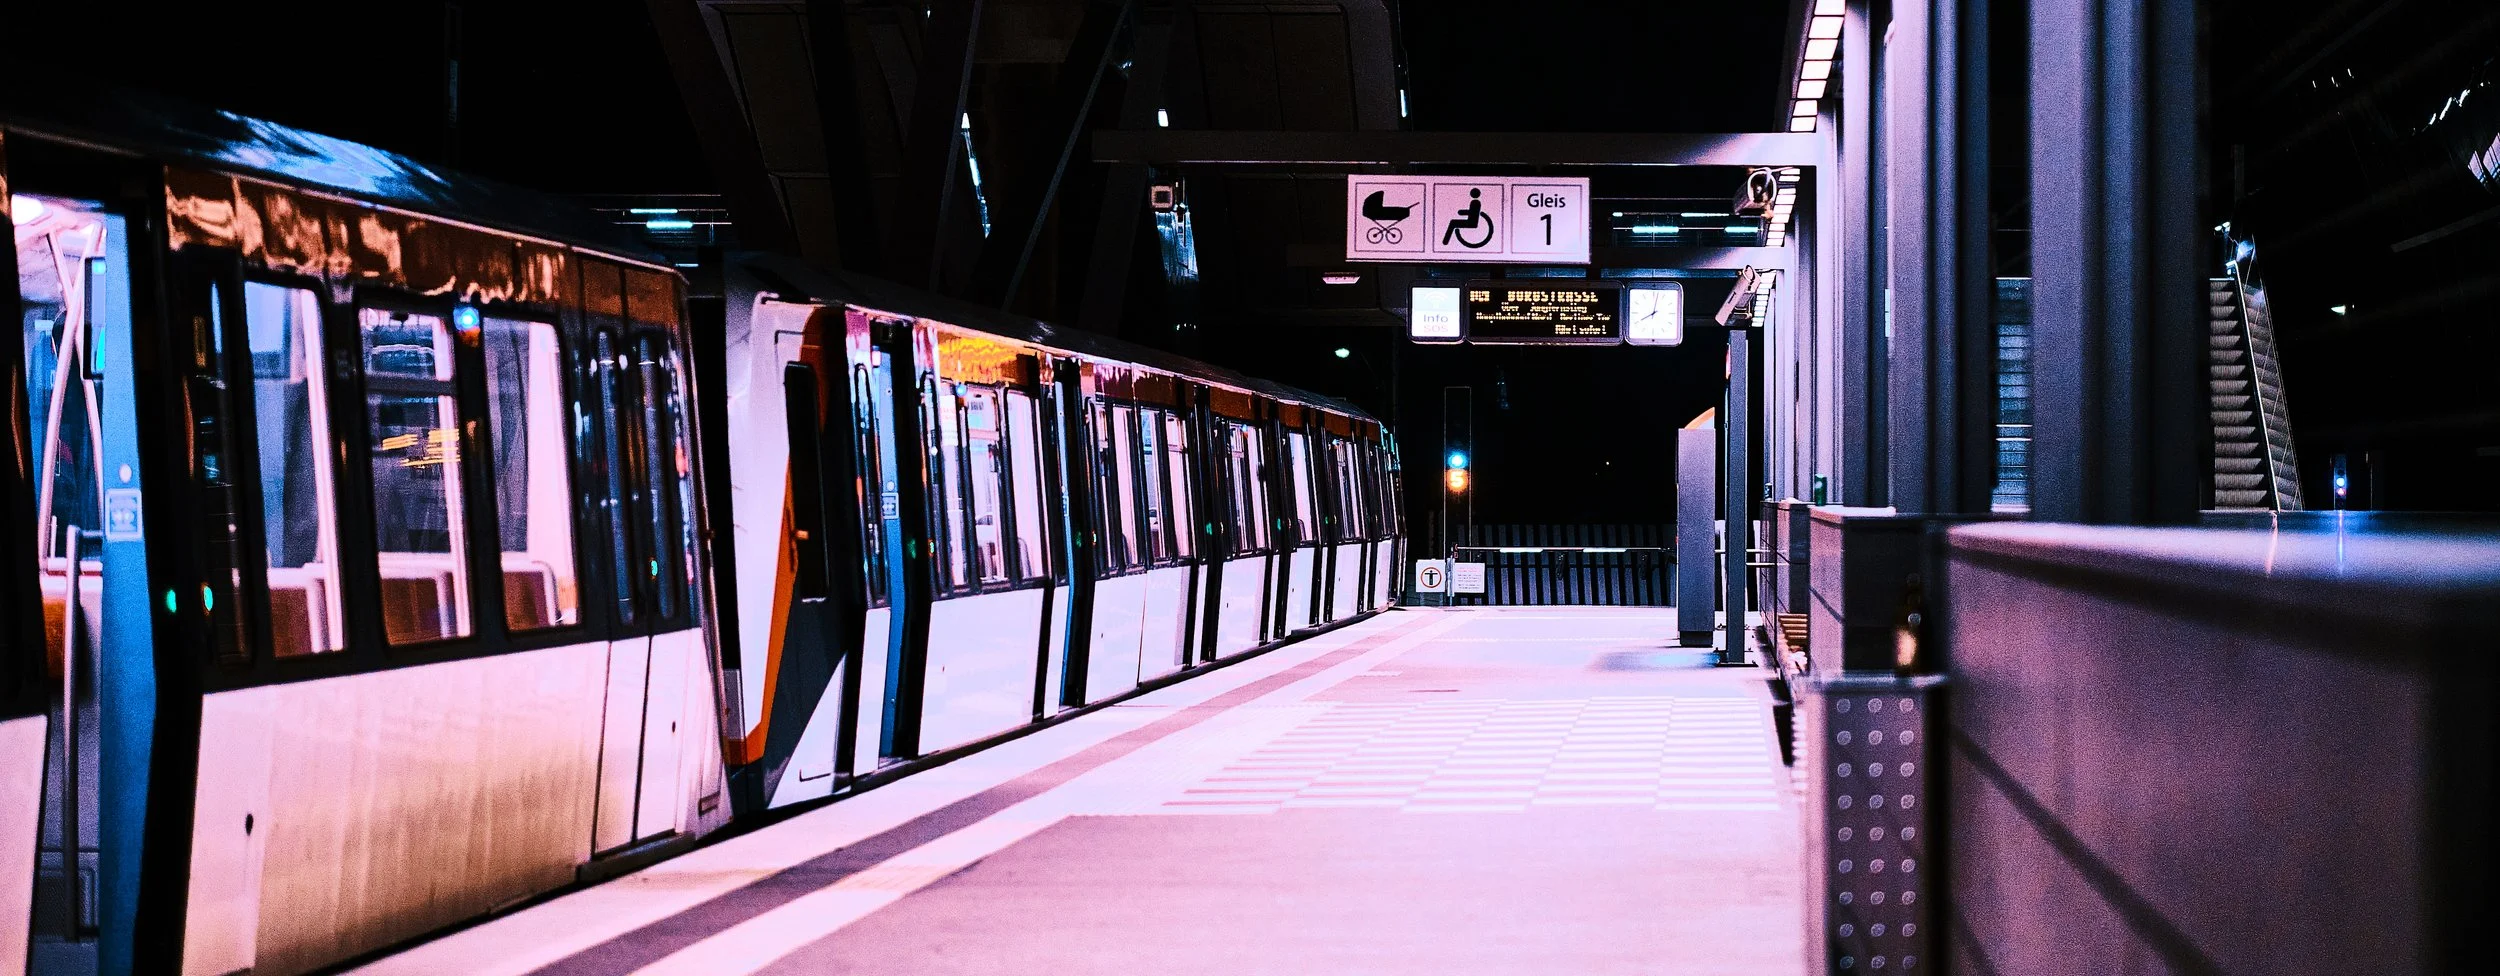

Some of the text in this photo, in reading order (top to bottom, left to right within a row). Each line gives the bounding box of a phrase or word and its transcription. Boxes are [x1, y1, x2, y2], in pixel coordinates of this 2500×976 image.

[1527, 192, 1566, 208] Gleis
[1540, 213, 1552, 246] 1
[1508, 291, 1598, 302] BURGSTRASSE
[1424, 314, 1449, 323] Info
[1424, 325, 1448, 333] SOS
